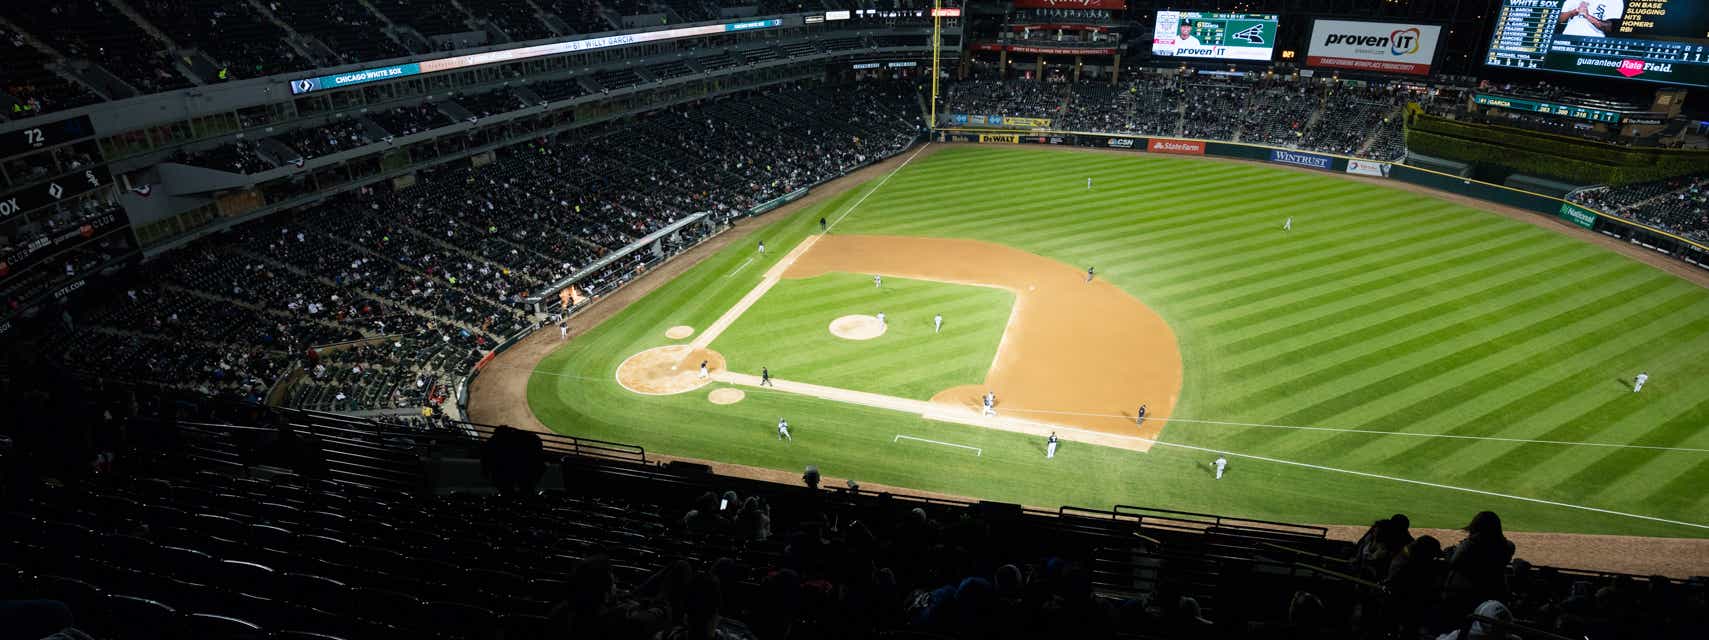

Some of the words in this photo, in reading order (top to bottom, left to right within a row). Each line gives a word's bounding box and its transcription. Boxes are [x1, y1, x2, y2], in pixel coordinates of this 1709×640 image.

[1626, 8, 1666, 16] SLUGGING
[608, 36, 634, 45] GARCIA
[1325, 33, 1389, 48] proven
[1397, 36, 1414, 48] IT
[1176, 47, 1213, 57] proven
[1216, 48, 1227, 56] IT
[1576, 57, 1622, 68] guaranteed
[1621, 60, 1643, 70] Rate
[1643, 62, 1673, 73] Field.
[336, 73, 366, 85] CHICAGO
[366, 70, 389, 81] WHITE
[388, 68, 402, 77] SOX
[23, 128, 45, 145] 72
[1116, 138, 1135, 147] CSN
[0, 197, 21, 217] OX
[1568, 207, 1595, 224] National
